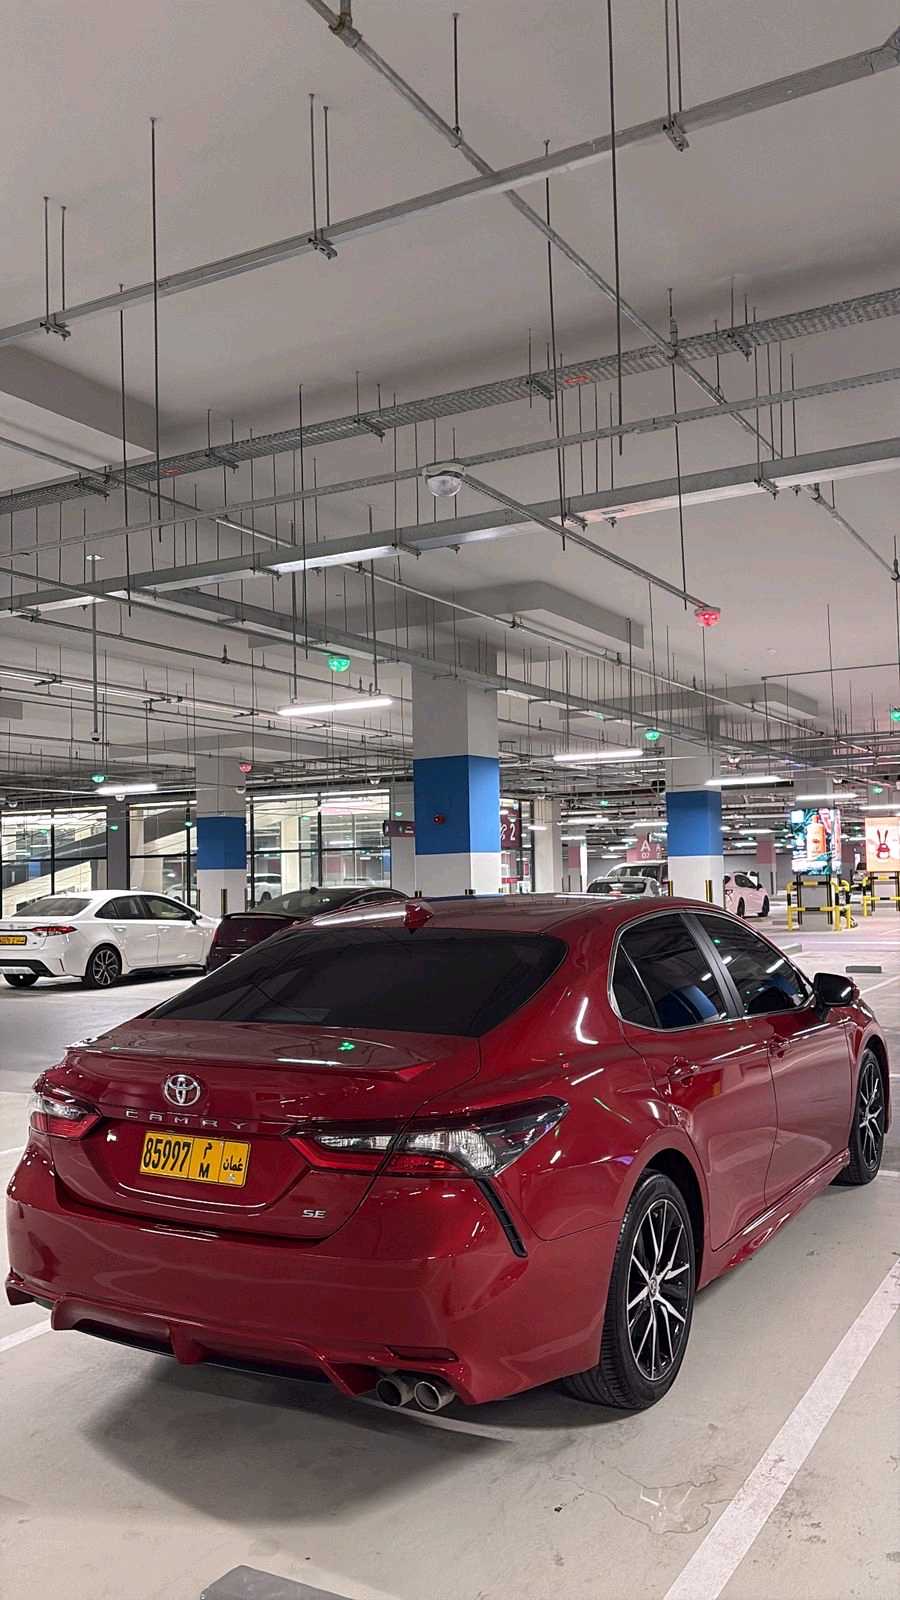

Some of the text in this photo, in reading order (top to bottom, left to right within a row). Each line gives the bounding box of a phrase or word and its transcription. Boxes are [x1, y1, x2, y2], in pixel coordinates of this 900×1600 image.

[640, 839, 651, 852] A
[125, 1108, 248, 1130] CAMRY
[143, 1138, 192, 1172] 85997
[203, 1142, 213, 1160] م
[199, 1162, 210, 1179] M
[301, 1209, 327, 1219] SE
